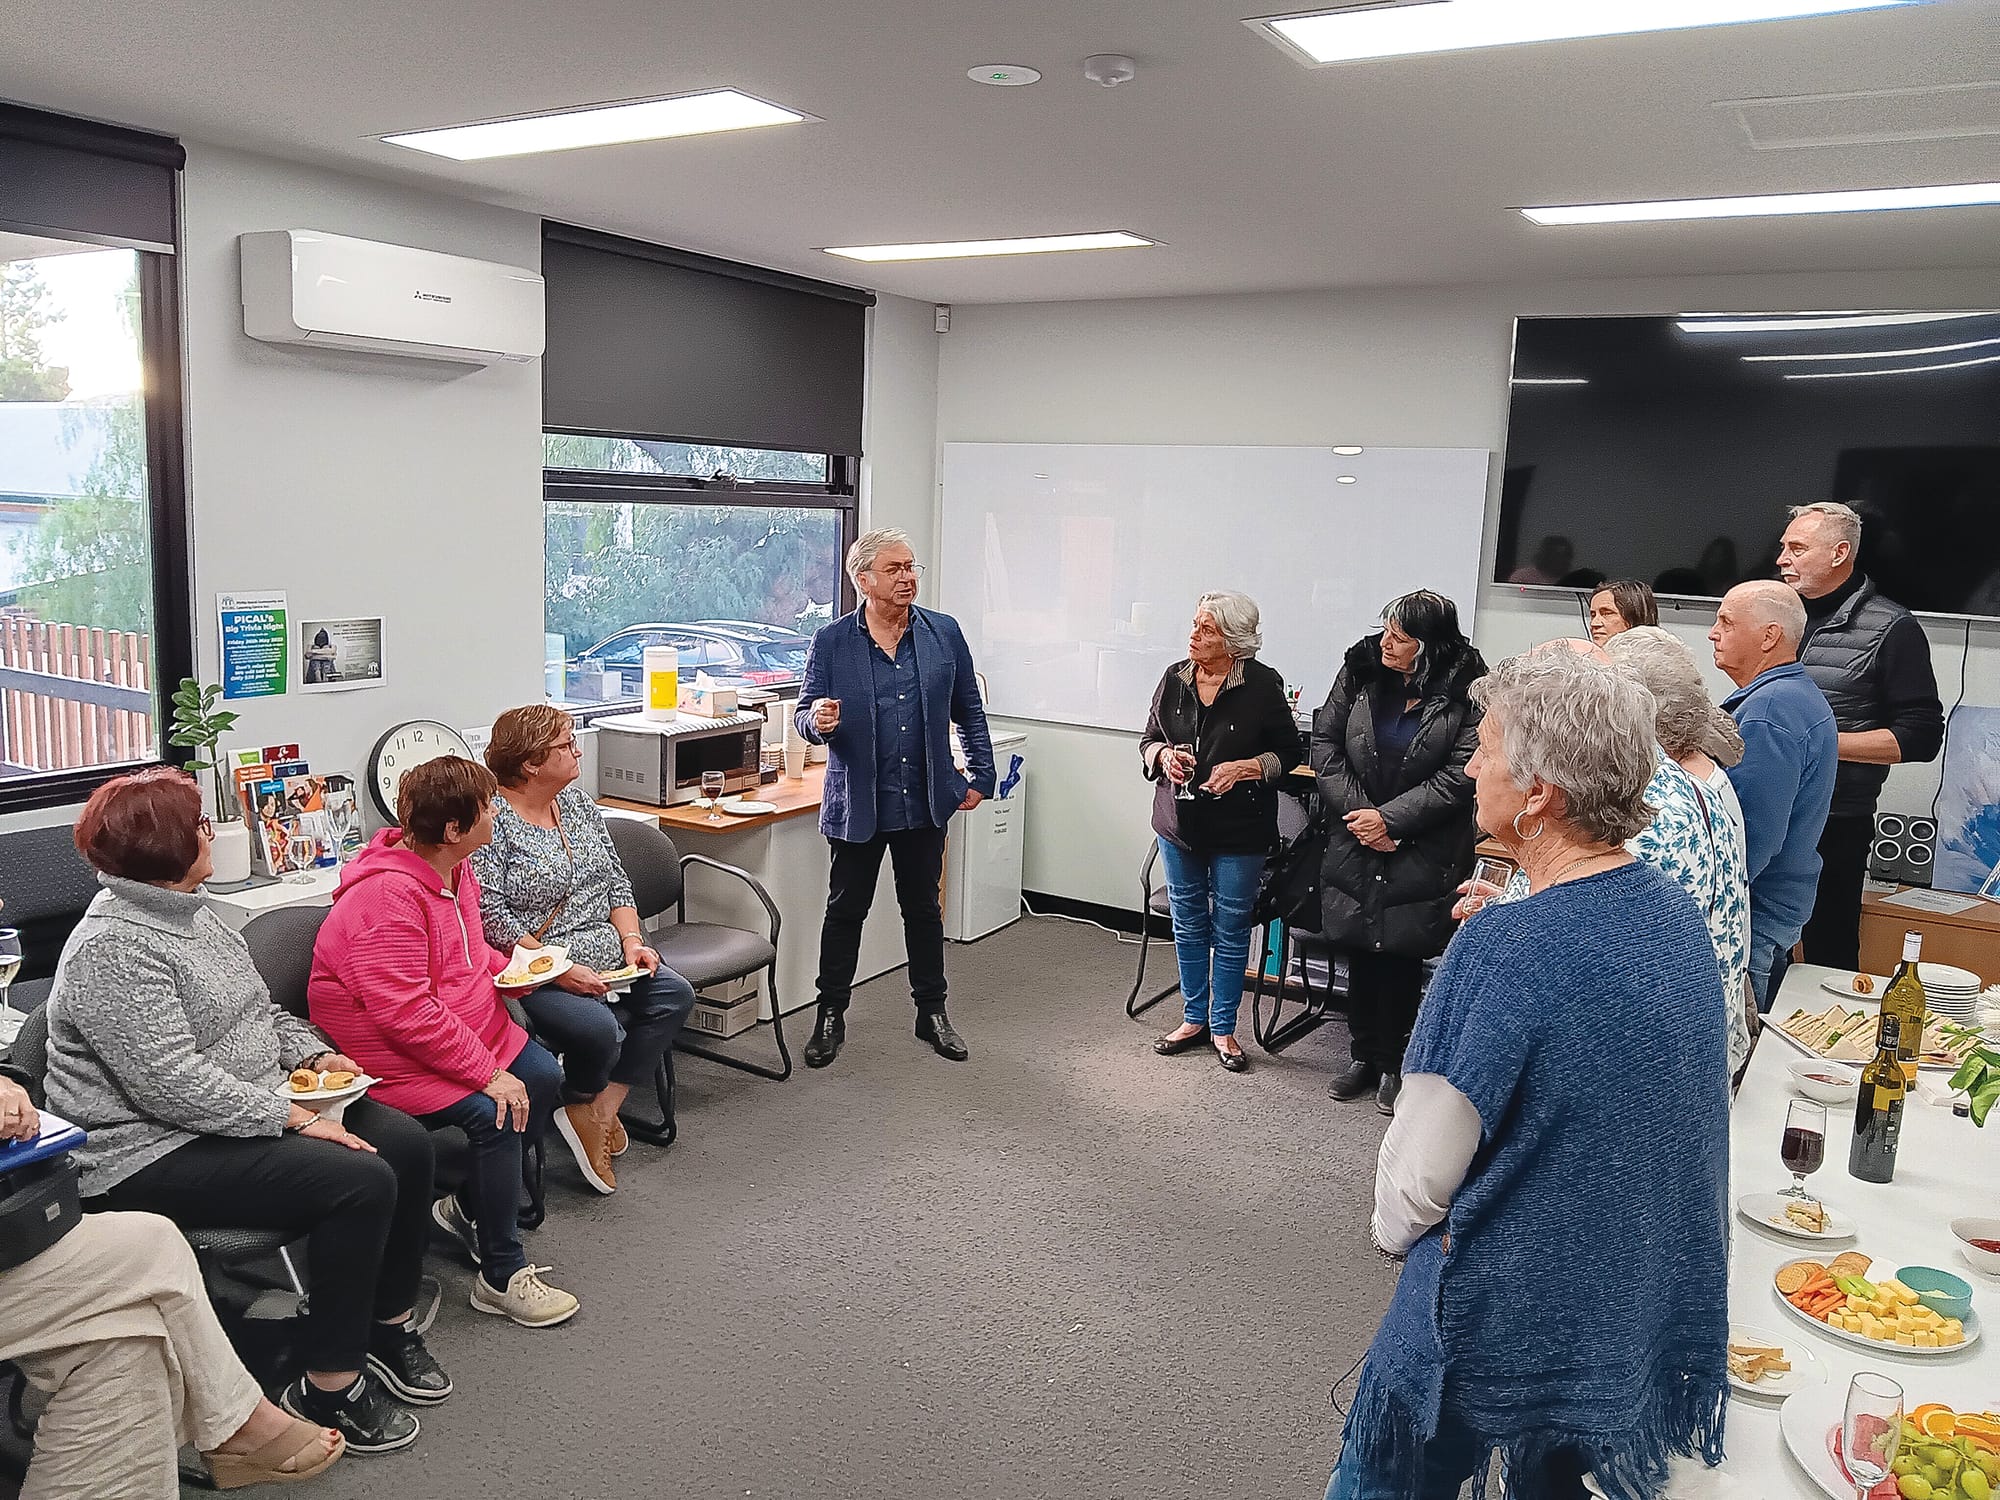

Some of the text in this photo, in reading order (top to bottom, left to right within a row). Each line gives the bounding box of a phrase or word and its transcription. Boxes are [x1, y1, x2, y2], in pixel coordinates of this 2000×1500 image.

[234, 614, 274, 624] PICAL's
[225, 622, 284, 633] Big Trivia Night
[413, 730, 424, 742] 12
[435, 734, 440, 746] 1
[396, 737, 406, 751] 11
[383, 754, 395, 768] 10
[383, 776, 391, 790] 9
